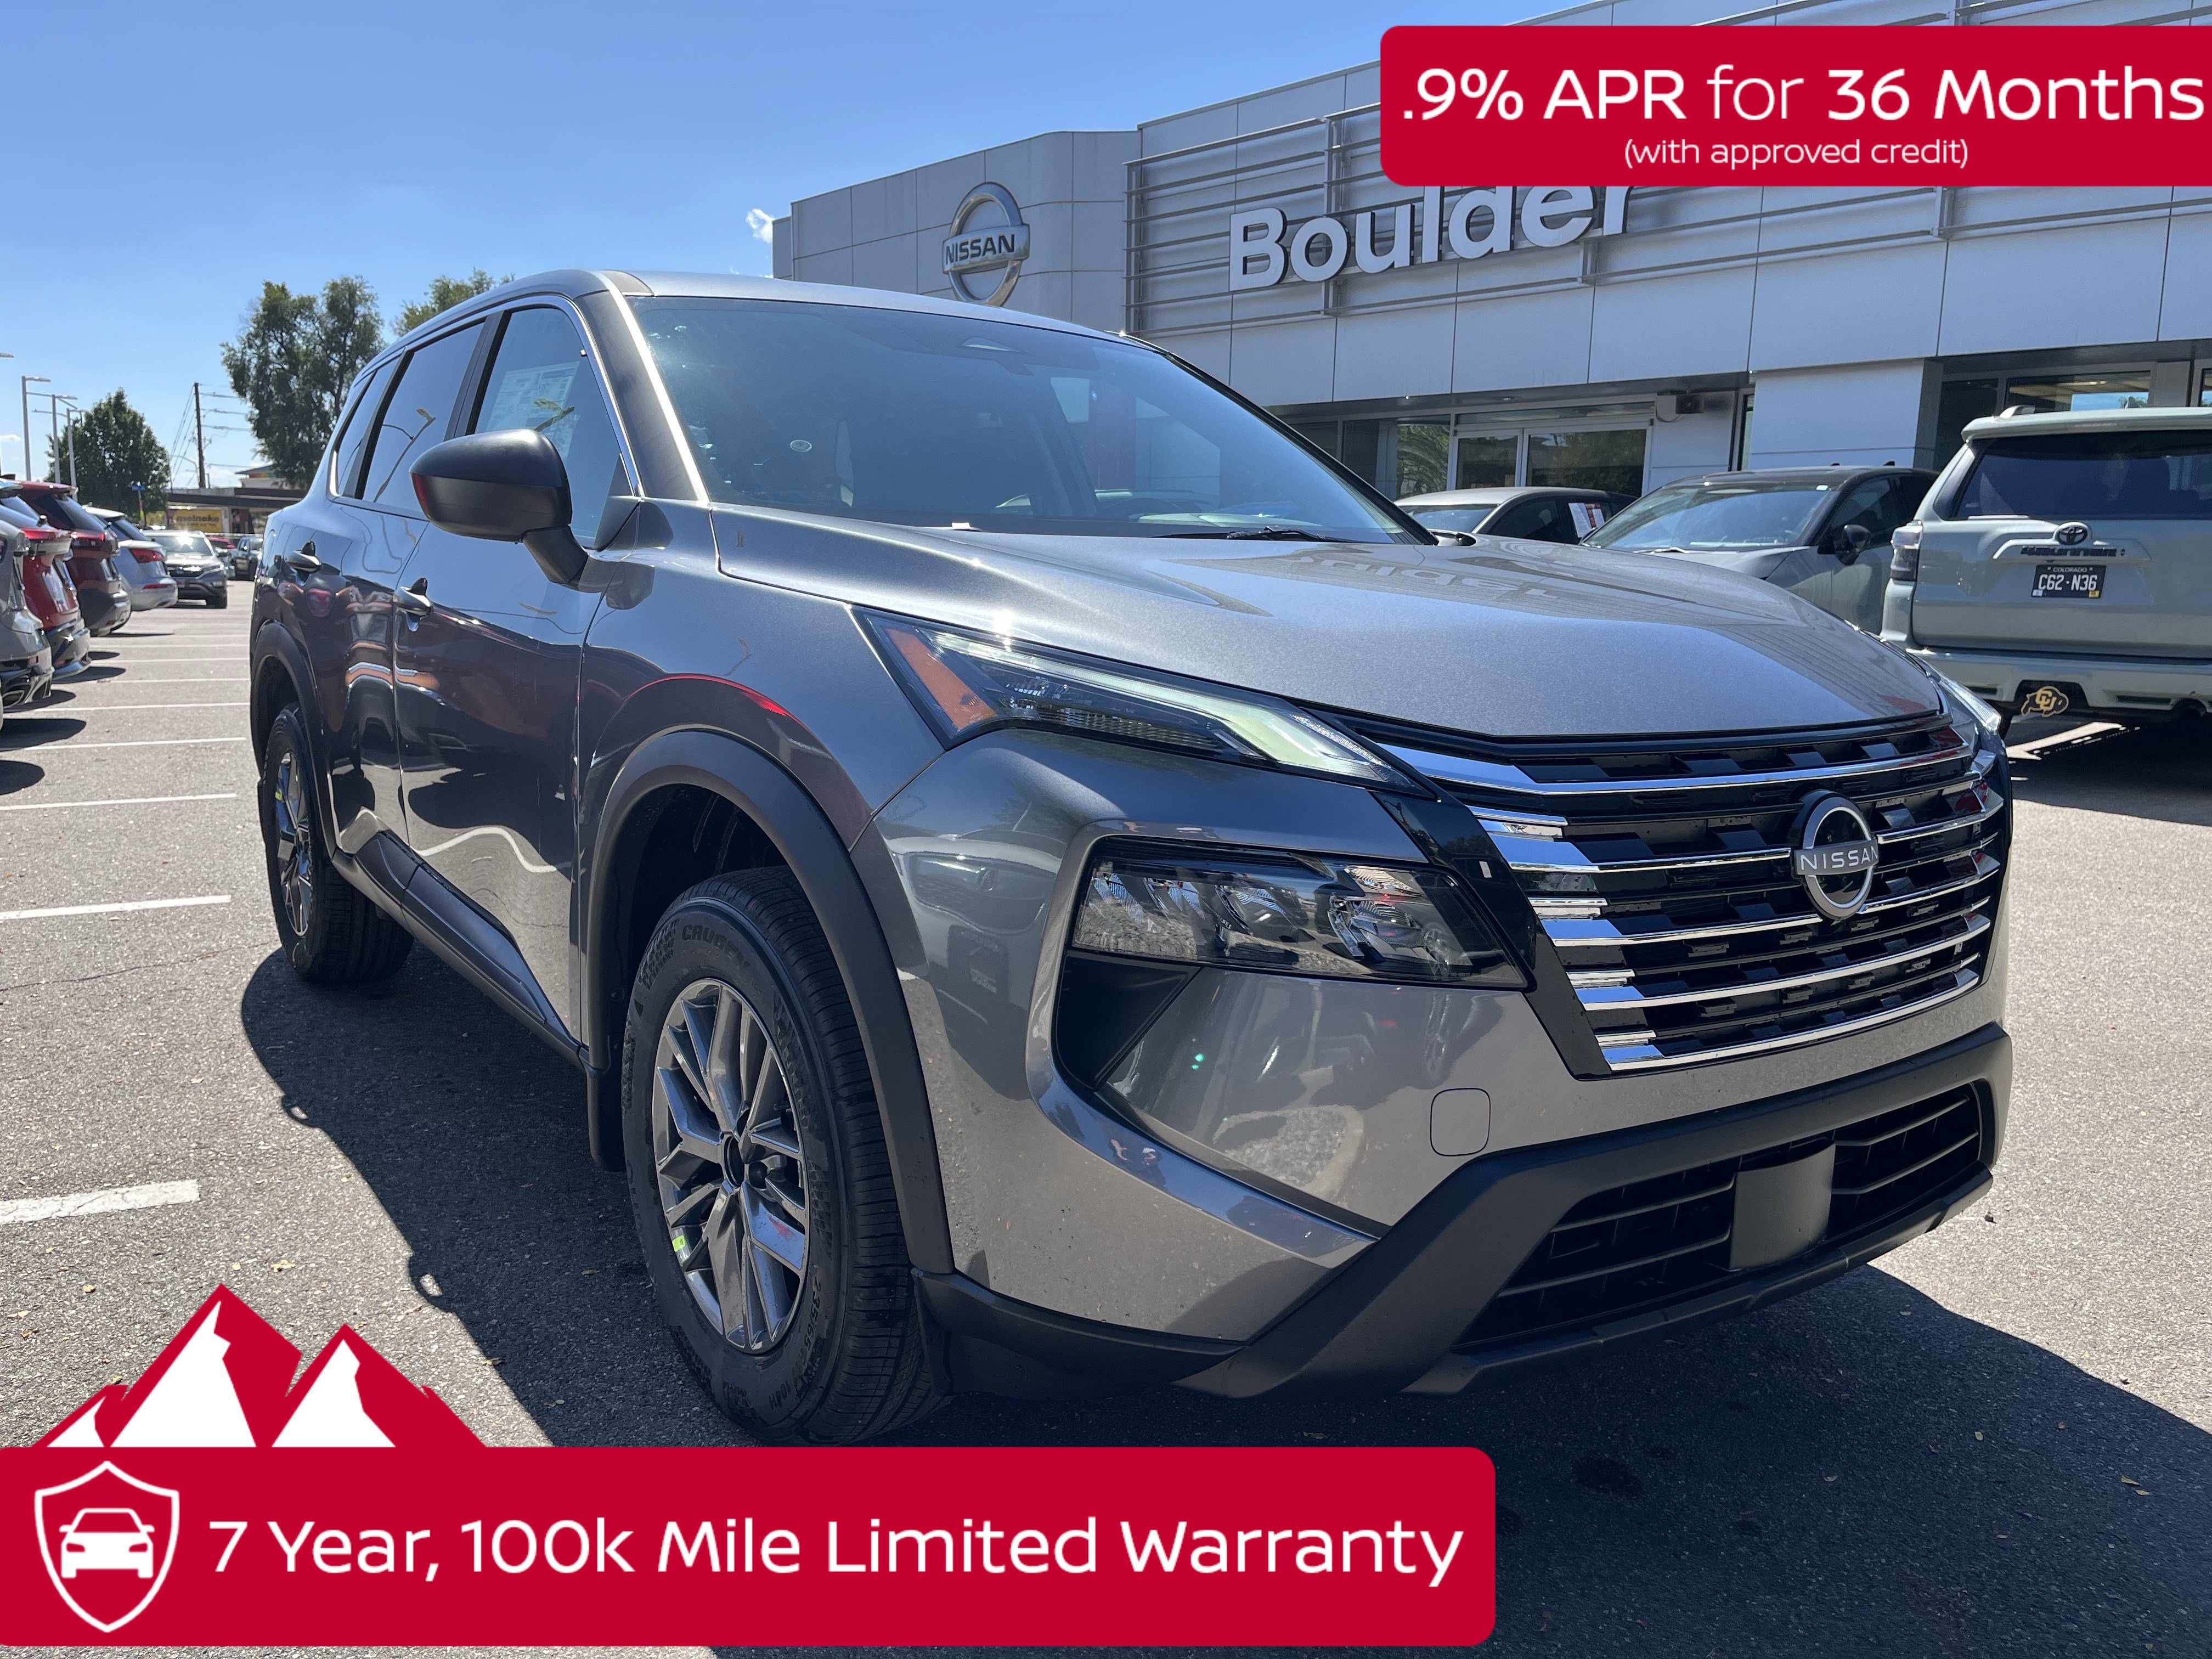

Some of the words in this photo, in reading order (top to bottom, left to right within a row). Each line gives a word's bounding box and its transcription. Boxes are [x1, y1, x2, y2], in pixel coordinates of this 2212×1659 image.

[945, 233, 1015, 266] NISSAN
[1229, 186, 1634, 292] Boulder
[1800, 845, 1878, 871] NISSAN
